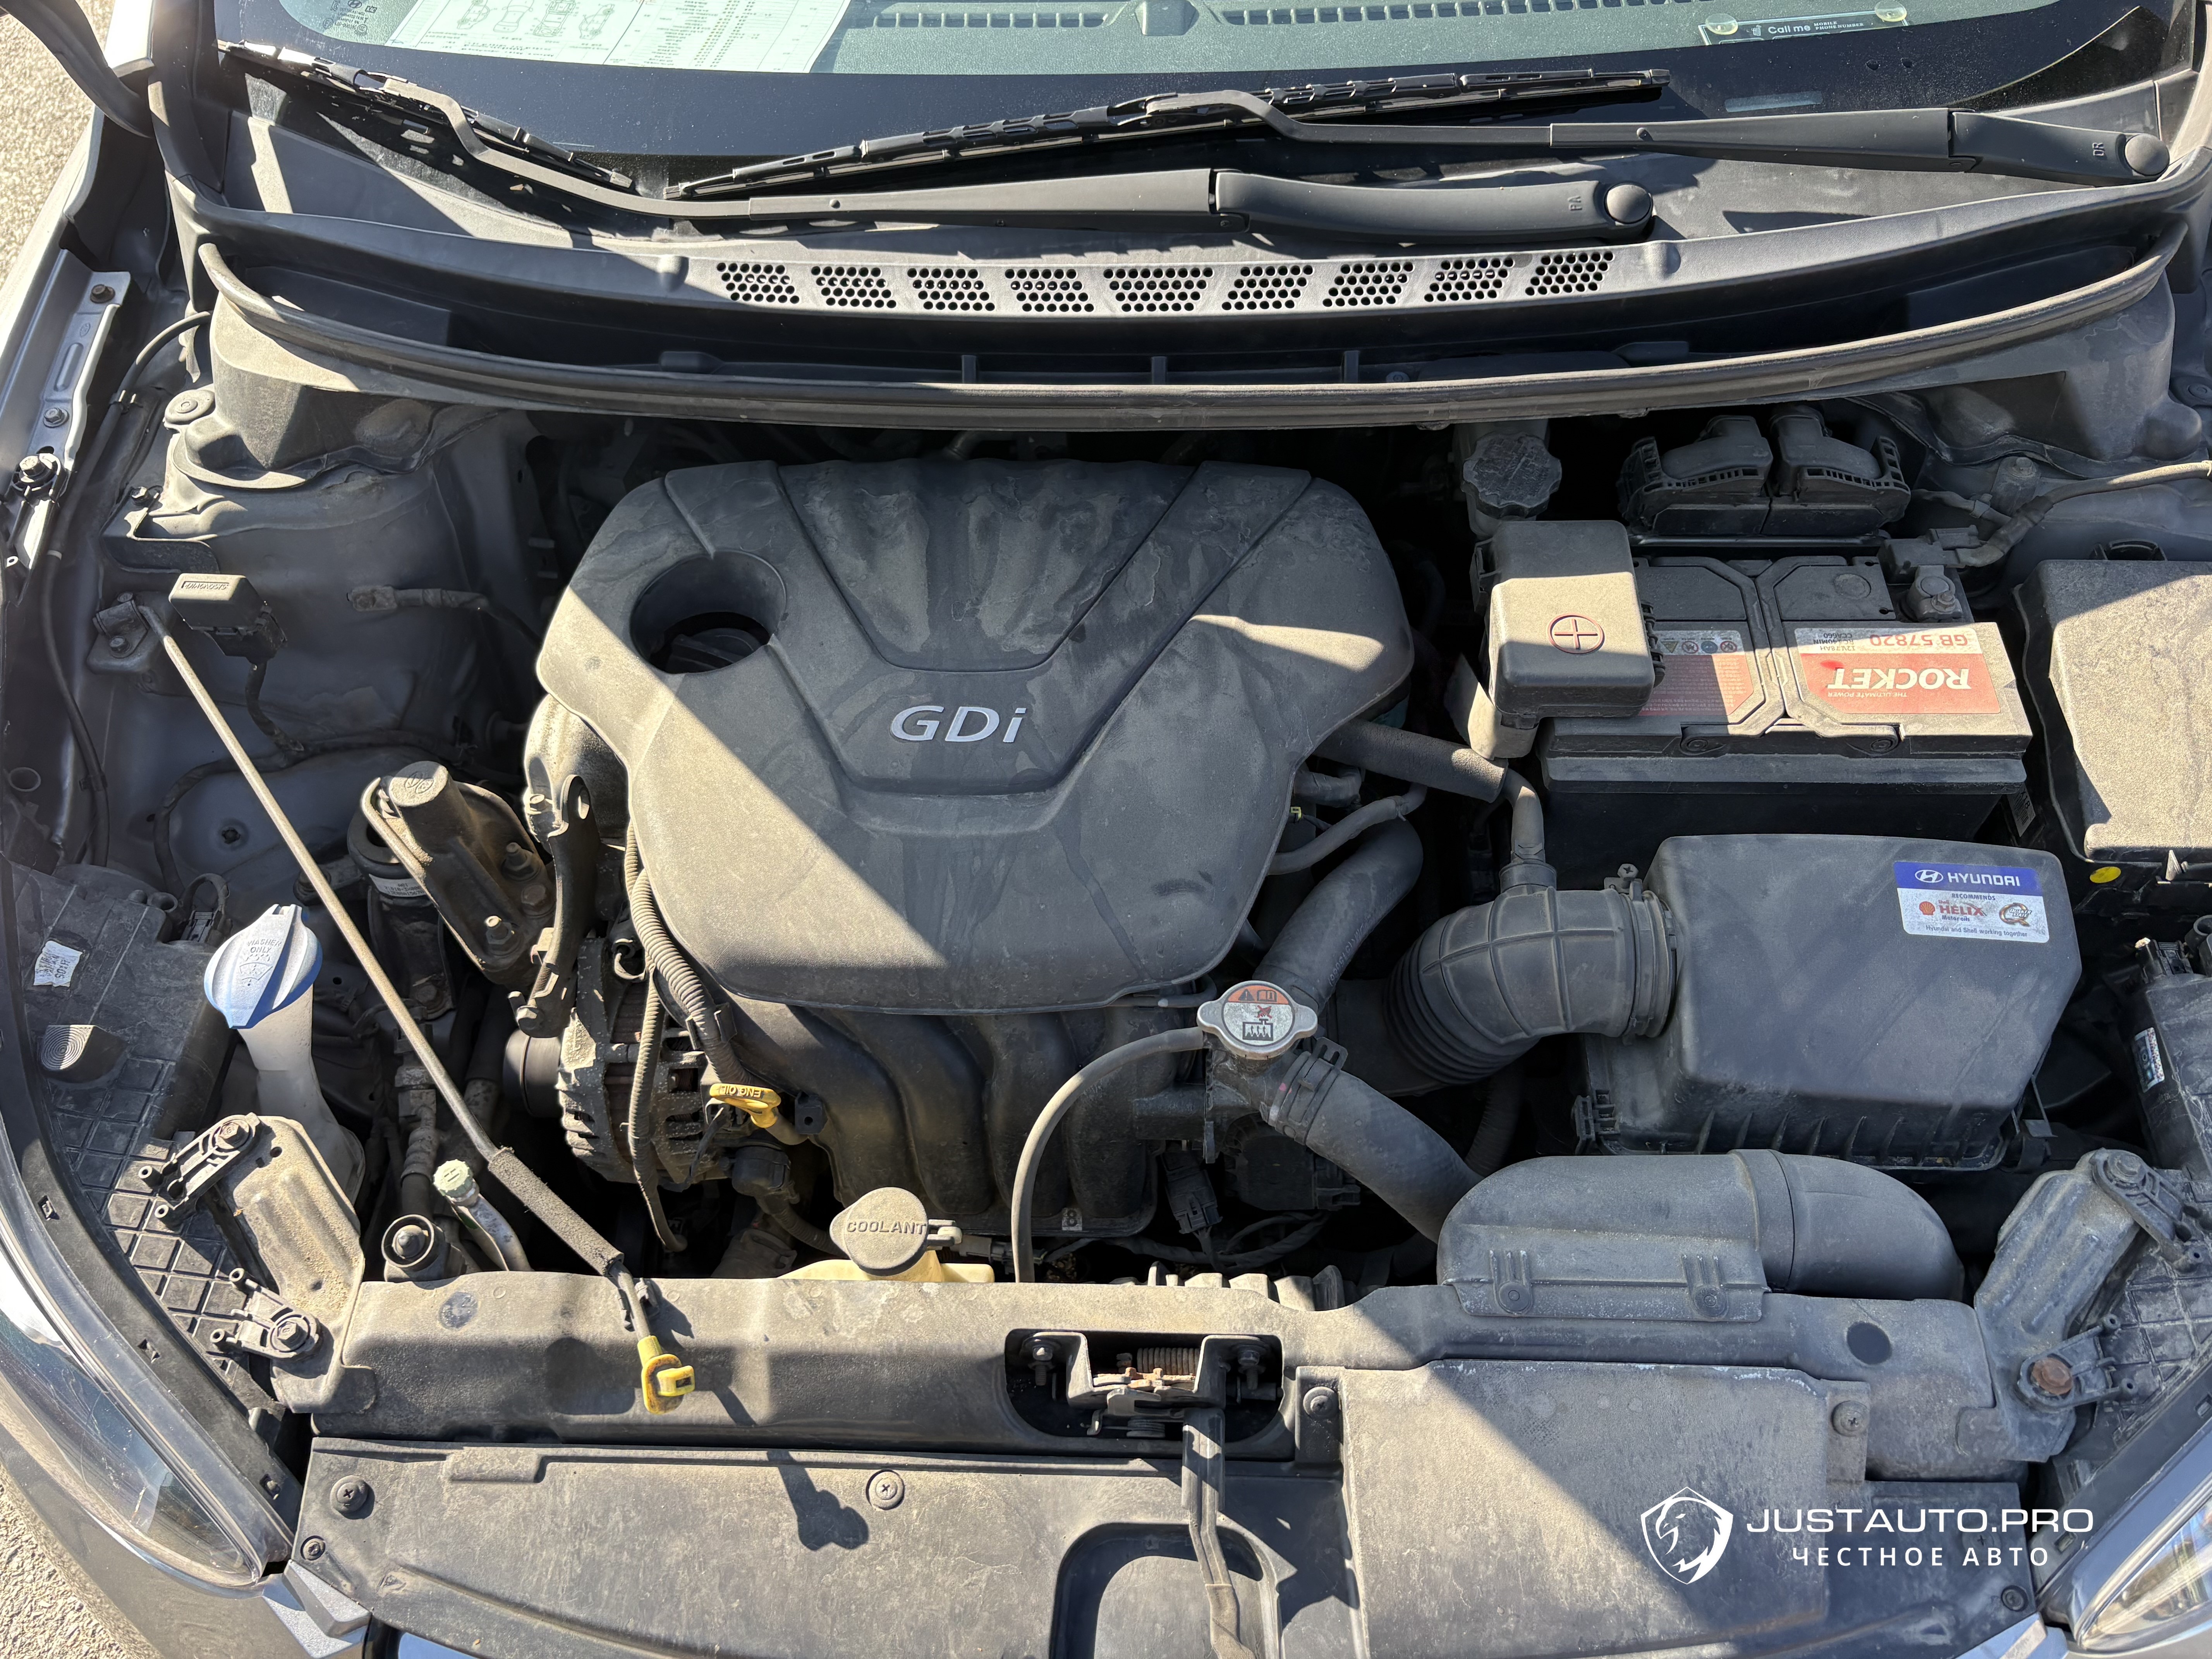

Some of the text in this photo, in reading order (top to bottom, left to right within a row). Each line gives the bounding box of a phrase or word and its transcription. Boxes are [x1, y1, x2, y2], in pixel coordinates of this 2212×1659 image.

[1768, 24, 1811, 34] Call me
[1870, 634, 1968, 646] GB 57820
[1826, 667, 1972, 689] ROCKET
[891, 705, 1027, 743] GDi
[1947, 872, 2021, 886] HYUNDAI
[1939, 905, 1987, 917] HELIX
[721, 1085, 762, 1098] ENG OIL
[847, 1220, 926, 1235] COOLANT
